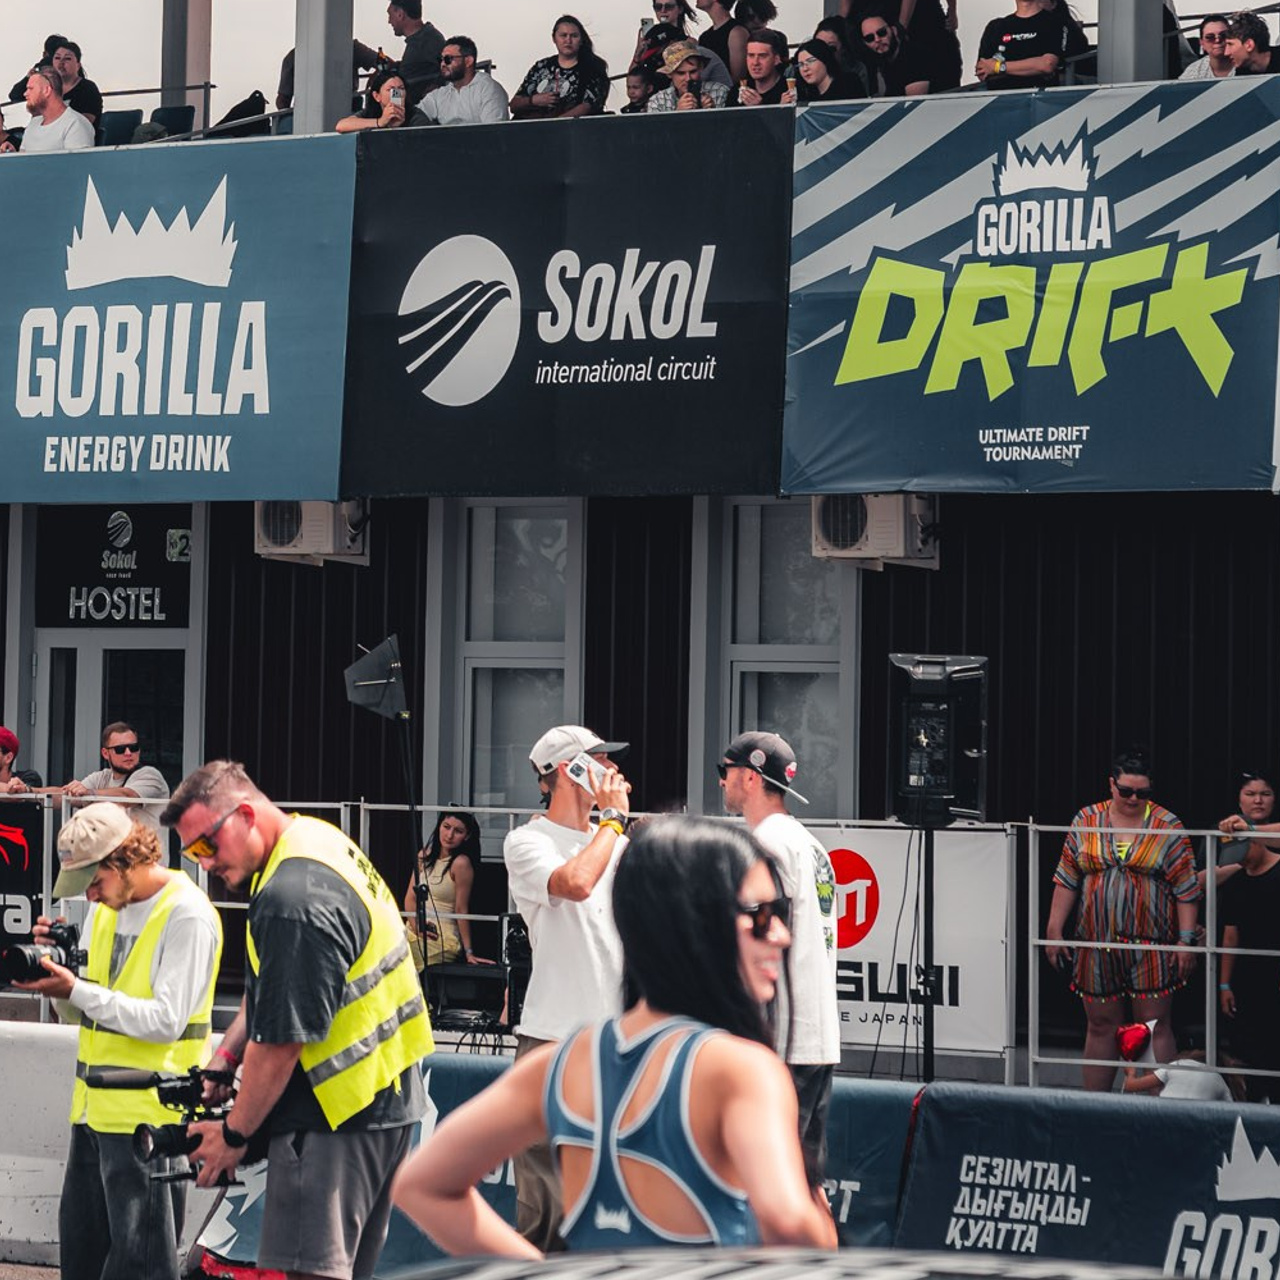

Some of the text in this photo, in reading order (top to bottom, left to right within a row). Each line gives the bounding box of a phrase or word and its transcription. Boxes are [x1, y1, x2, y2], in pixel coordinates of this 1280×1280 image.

[977, 196, 1111, 256] GORILLA
[834, 241, 1248, 402] DRIFT
[15, 301, 270, 418] GORILLA
[535, 355, 716, 384] international circuit
[44, 434, 232, 472] ENERGY DRINK
[978, 426, 1090, 445] ULTIMATE DRIFT
[983, 444, 1083, 462] TOURNAMENT
[69, 586, 166, 620] HOSTEL
[836, 960, 959, 1007] SUJI
[859, 1012, 923, 1026] JAPAN
[953, 1186, 1091, 1226] ДЫҒЫҢДЫ
[945, 1217, 1039, 1253] ҚУАТТА
[1163, 1210, 1280, 1280] GOR
